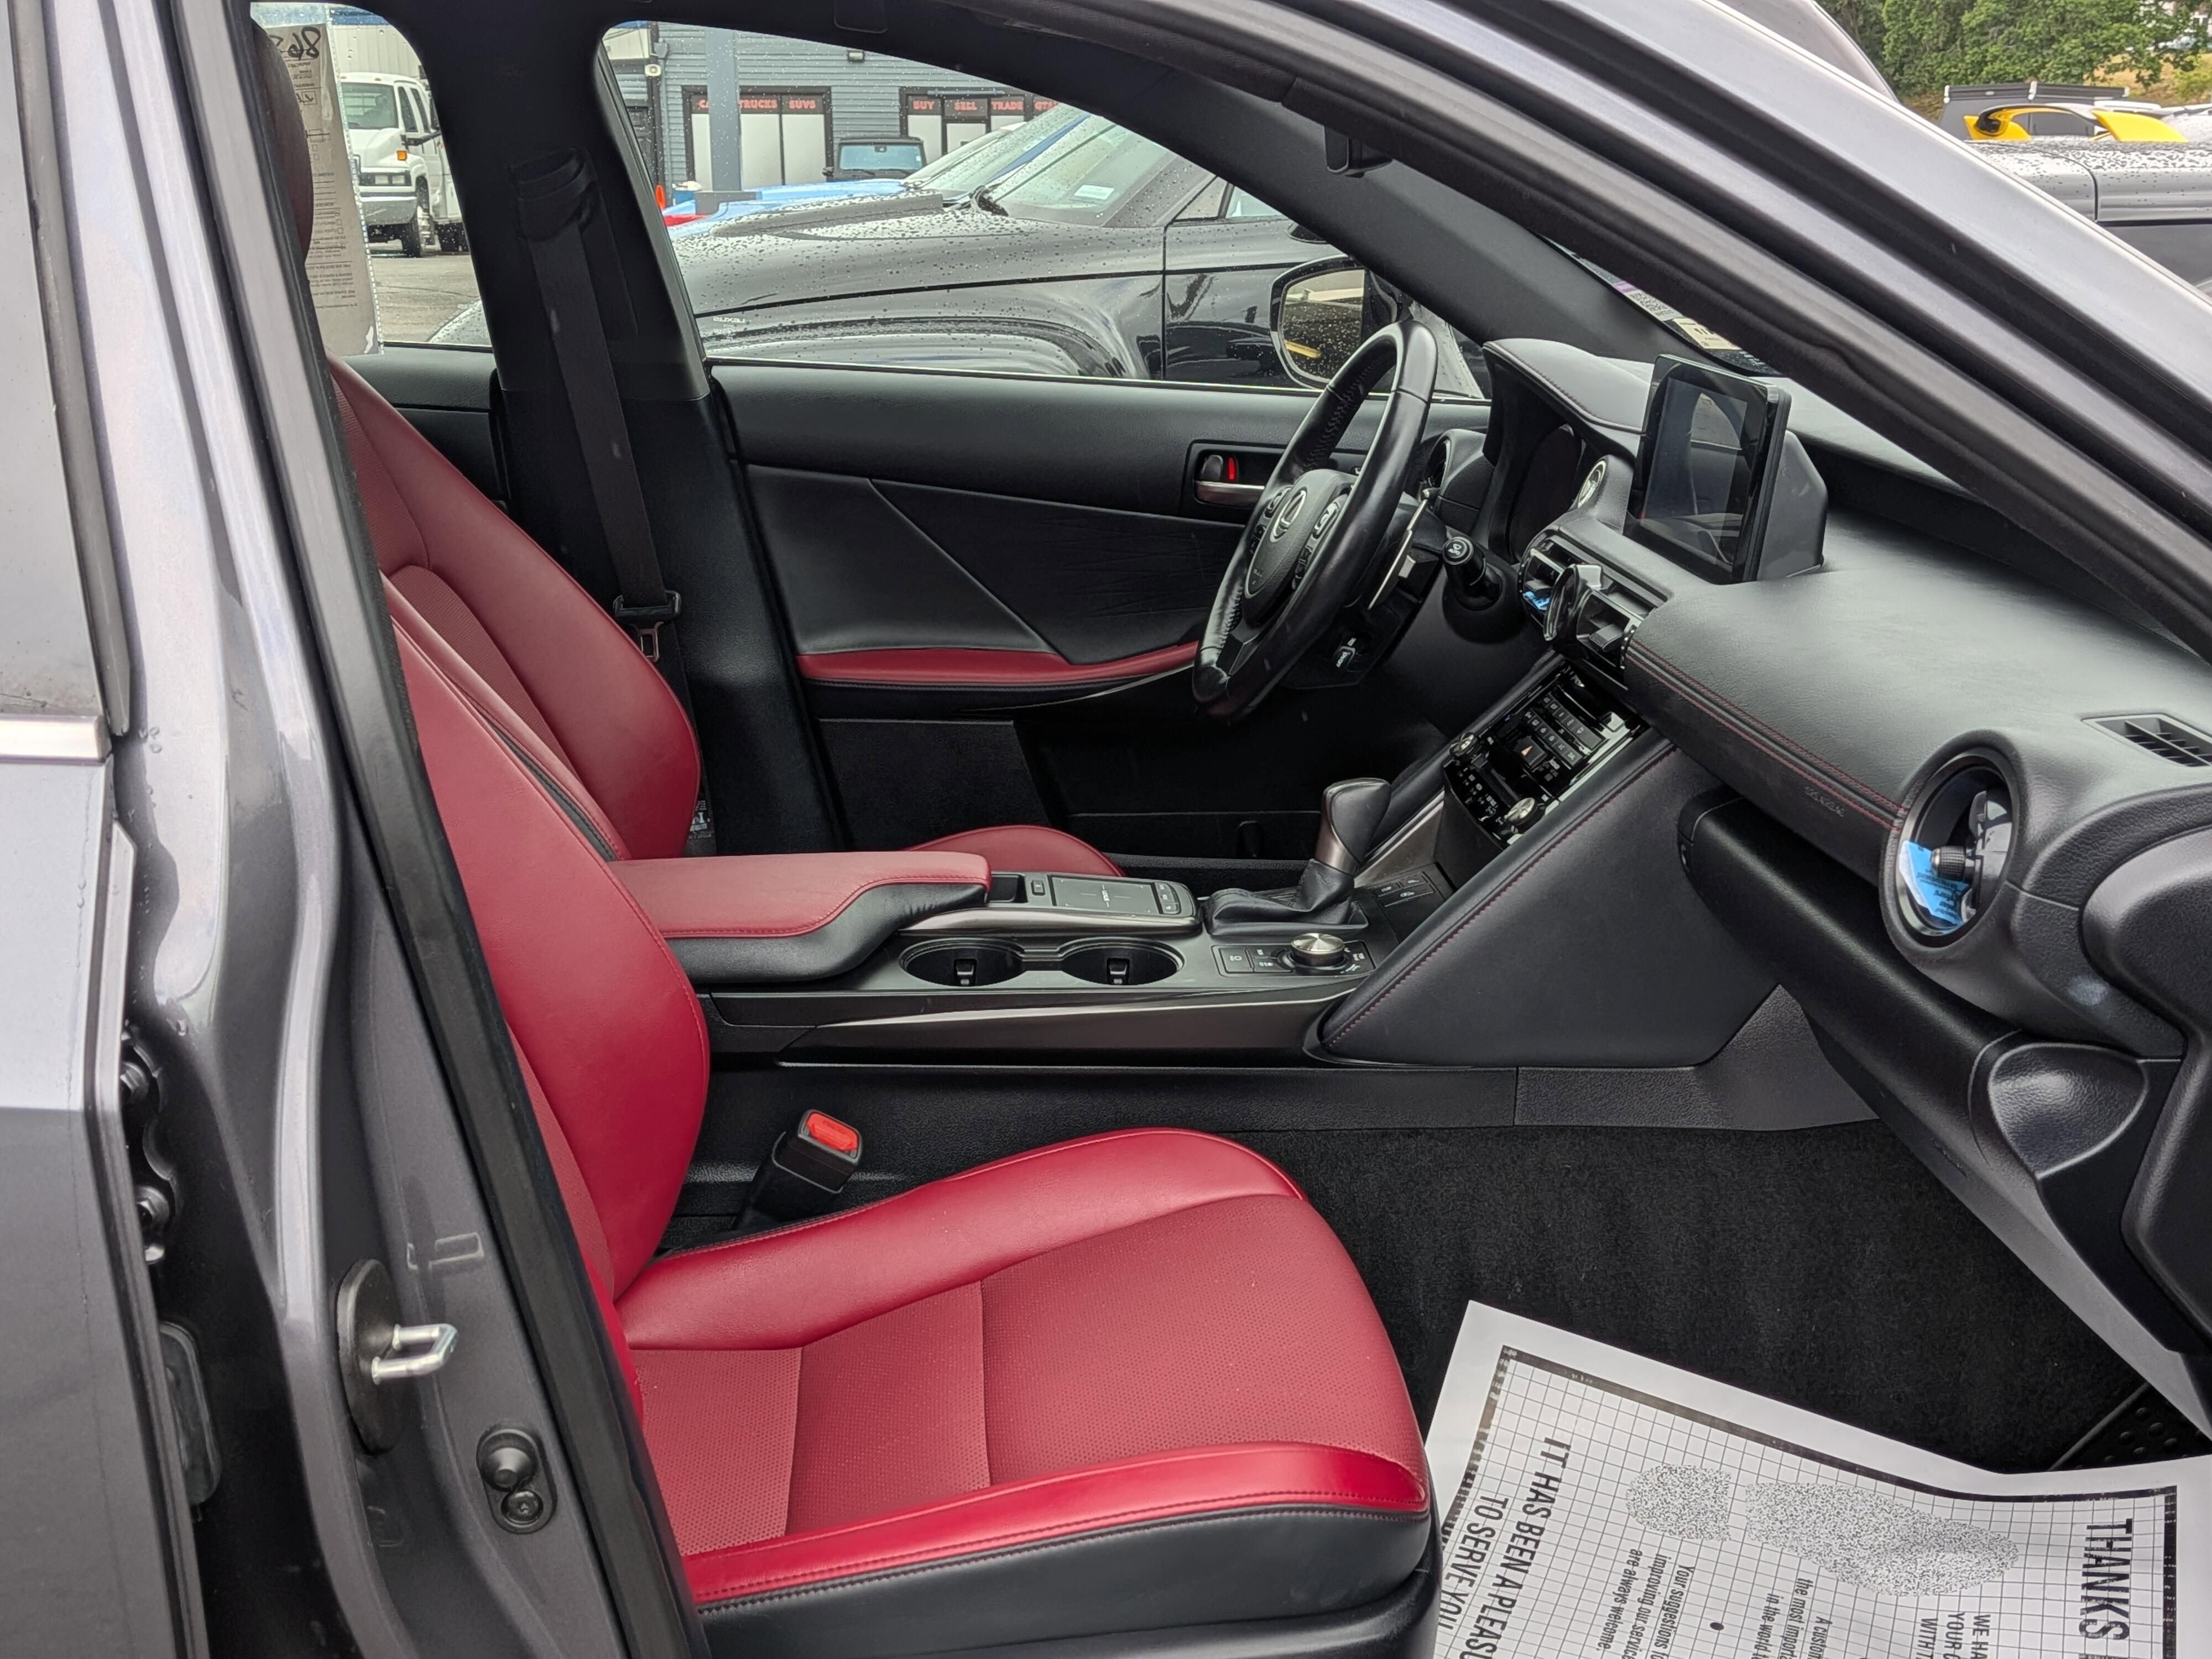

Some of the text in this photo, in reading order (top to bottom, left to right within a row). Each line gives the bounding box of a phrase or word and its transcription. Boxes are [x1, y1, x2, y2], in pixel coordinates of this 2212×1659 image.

[913, 100, 935, 110] BUY
[954, 101, 978, 111] SELL
[991, 101, 1023, 111] TRADE
[1540, 1437, 1572, 1469] IT
[1474, 1495, 1509, 1521] TO
[1522, 1471, 1562, 1519] HAS
[1444, 1522, 1496, 1588] SERVE
[1500, 1520, 1546, 1574] BEEN
[1492, 1573, 1523, 1590] A
[1637, 1553, 1672, 1606] improving
[1673, 1564, 1695, 1589] Your
[1794, 1578, 1814, 1596] the
[2079, 1518, 2133, 1640] THANKS
[1595, 1548, 1643, 1651] are always welcome.
[1765, 1593, 1785, 1604] in
[1788, 1597, 1805, 1624] most
[1635, 1606, 1652, 1624] our
[1654, 1589, 1684, 1650] suggestions
[1761, 1605, 1781, 1623] the
[1814, 1616, 1833, 1625] A
[1972, 1614, 1991, 1636] WE
[1754, 1624, 1773, 1653] world
[1917, 1618, 1939, 1650] WITH
[1944, 1611, 1965, 1650] YOUR
